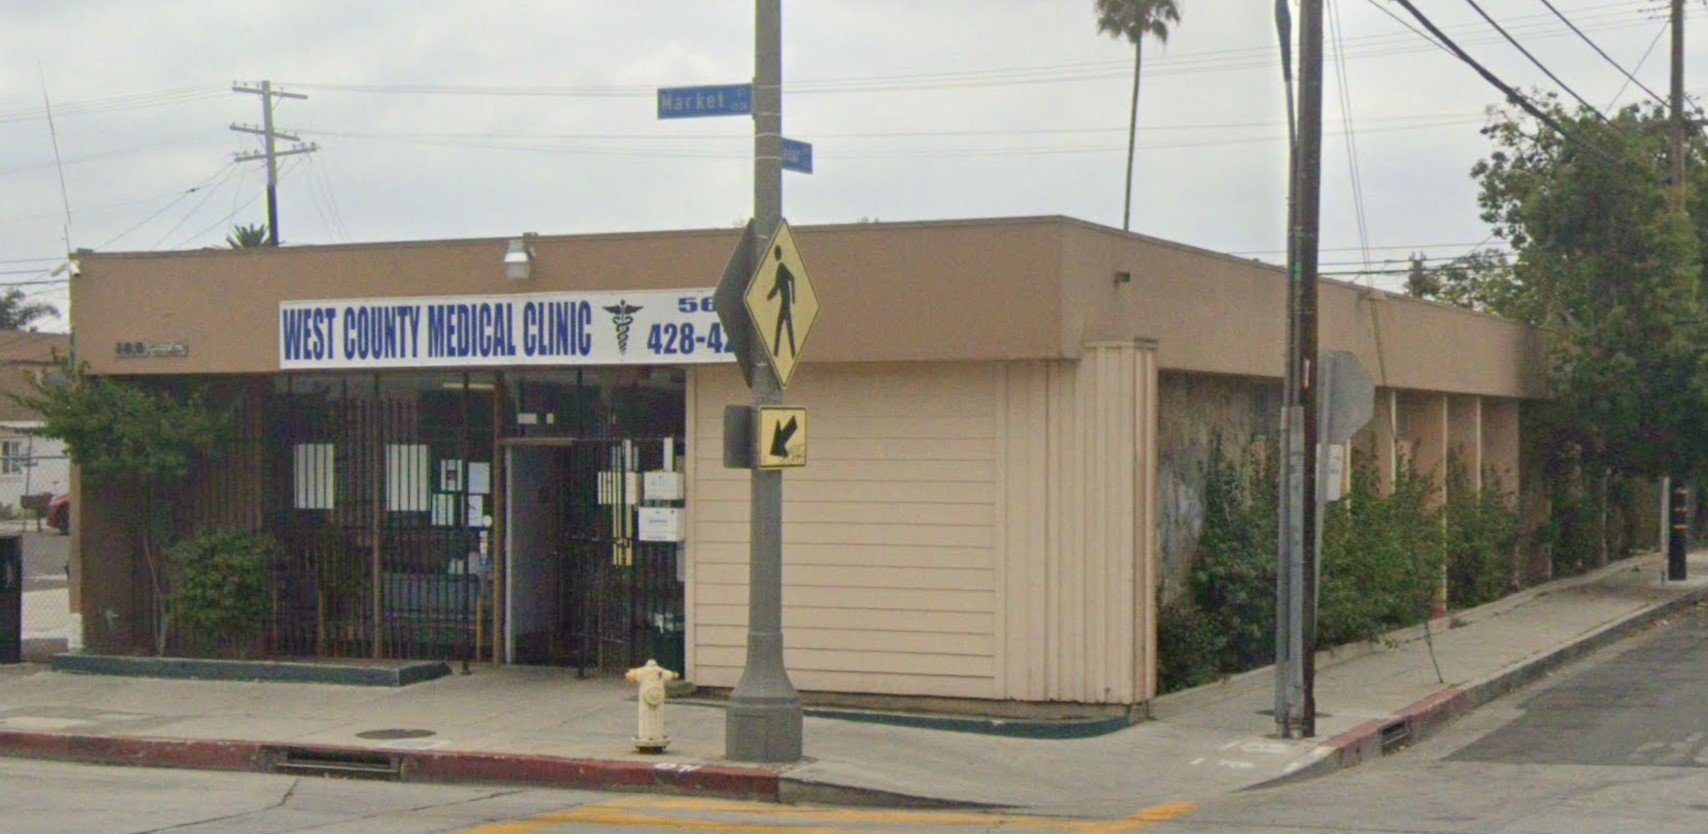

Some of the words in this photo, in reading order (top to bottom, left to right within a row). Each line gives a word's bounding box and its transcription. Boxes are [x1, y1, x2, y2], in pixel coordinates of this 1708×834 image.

[661, 92, 725, 111] Market
[282, 307, 336, 360] WEST
[343, 305, 421, 360] COUNTY
[428, 302, 516, 358] MEDICAL
[523, 300, 592, 357] CLINIC
